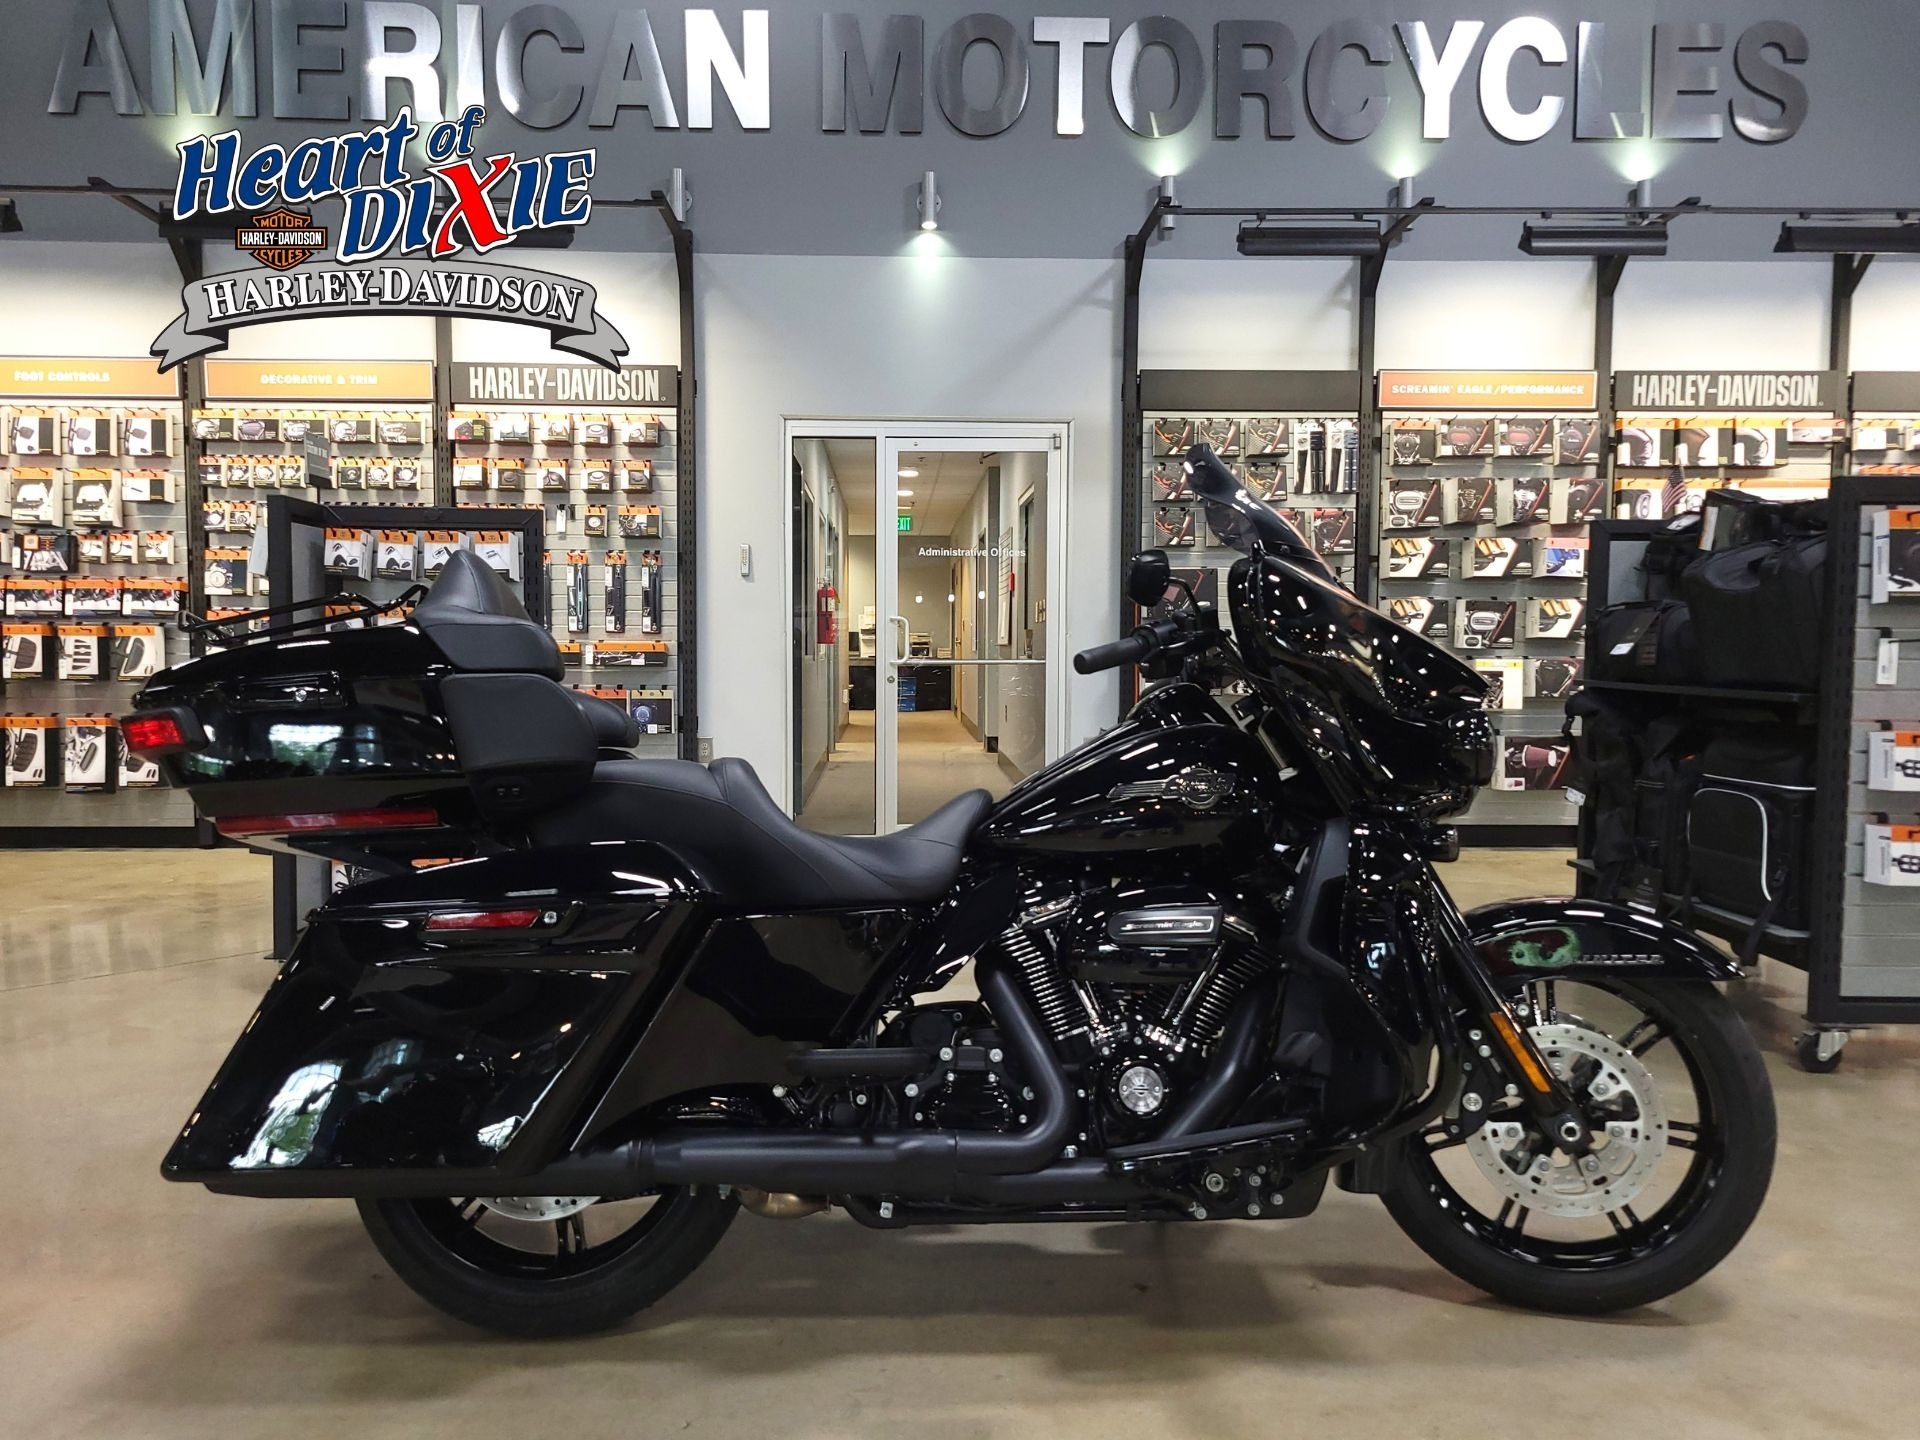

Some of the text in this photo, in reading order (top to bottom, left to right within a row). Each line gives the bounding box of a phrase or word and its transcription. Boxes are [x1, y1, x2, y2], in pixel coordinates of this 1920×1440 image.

[48, 0, 1809, 143] AMERICAN MOTORCYCLES
[13, 371, 111, 383] FOOT CONTROLS
[260, 374, 333, 385] DECORATIVE
[349, 374, 378, 385] TRIM
[469, 366, 660, 401] HARLEY-DAVIDSON
[1391, 384, 1454, 395] SCREAMIN'
[1631, 374, 1820, 407] HARLEY-DAVIDSON
[918, 547, 987, 558] Administrative
